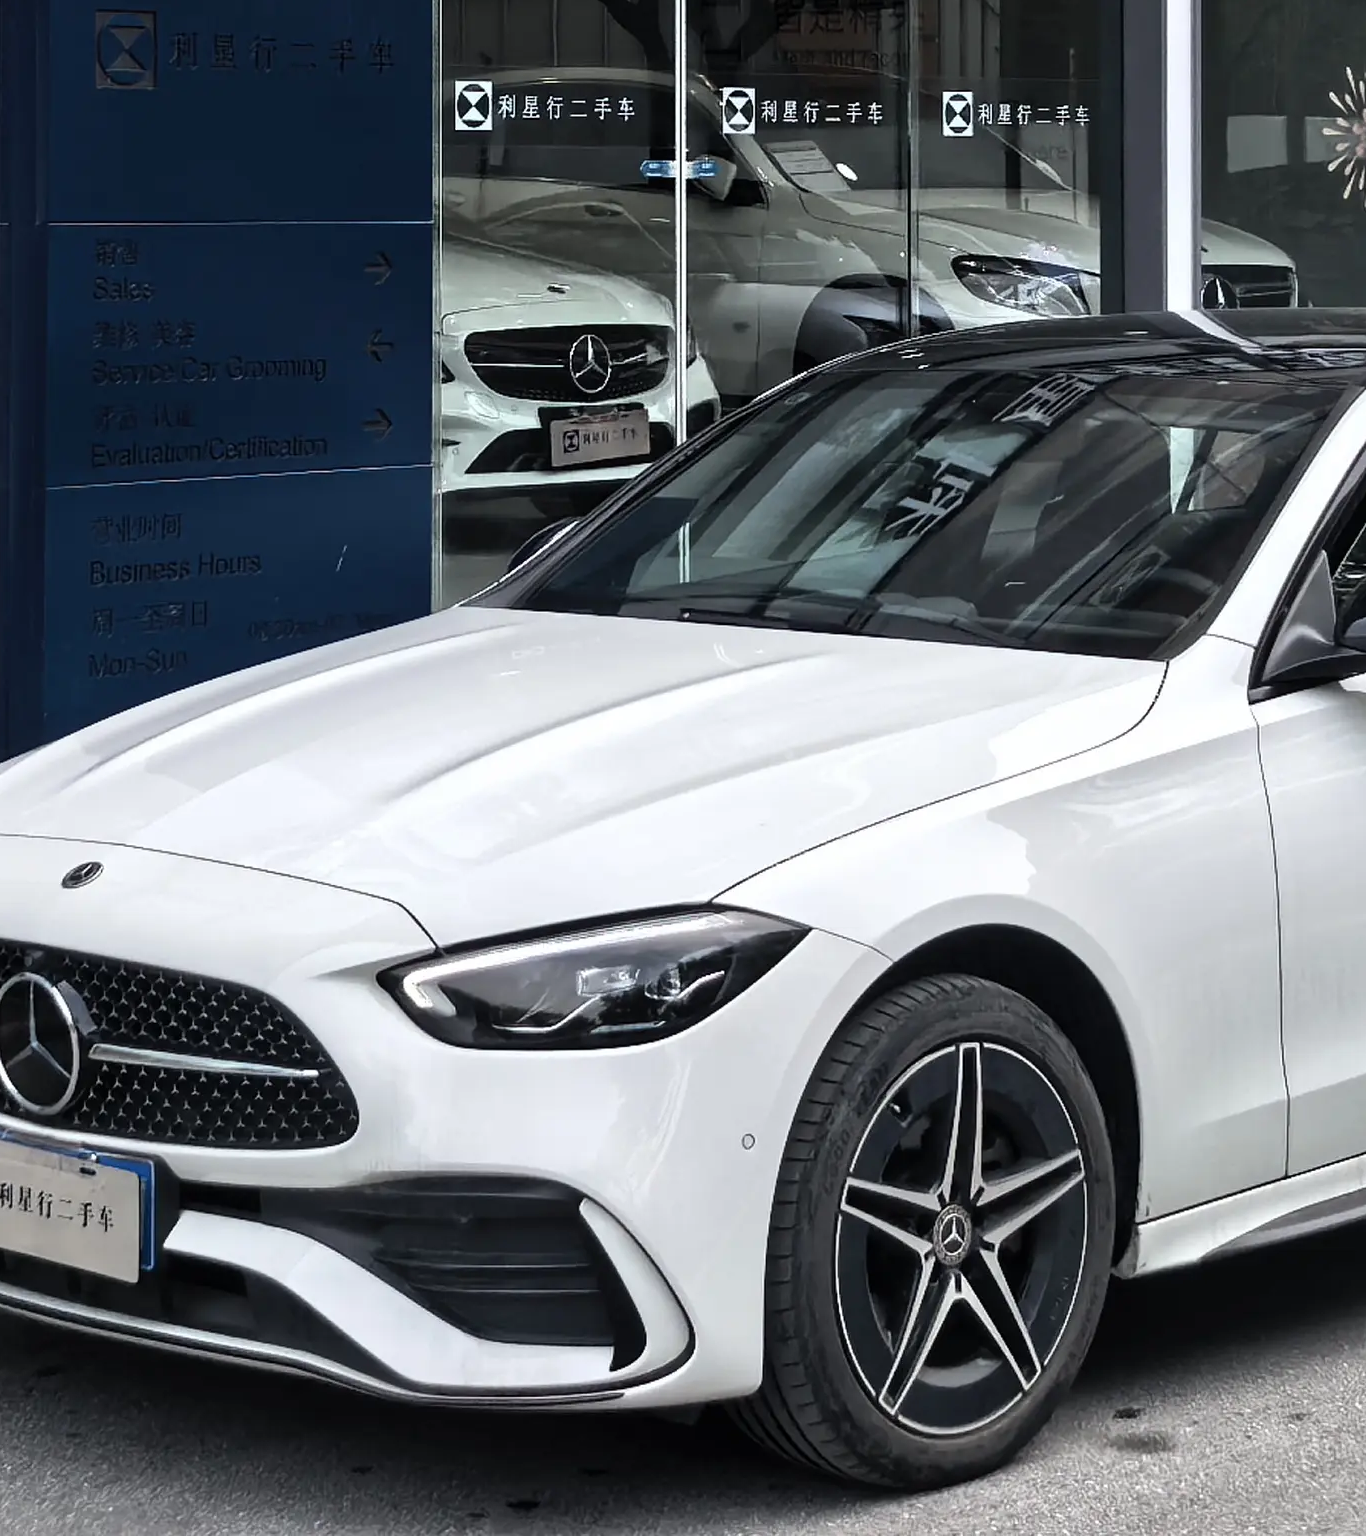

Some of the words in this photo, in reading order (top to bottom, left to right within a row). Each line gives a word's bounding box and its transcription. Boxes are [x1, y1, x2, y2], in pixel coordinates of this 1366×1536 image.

[168, 30, 396, 76] 利星行二手车
[498, 94, 636, 122] 利星行二手车
[761, 100, 884, 125] 利星行二手车
[977, 103, 1091, 127] 利星行二手车
[93, 275, 155, 302] Sales
[226, 353, 327, 385] Grooming
[89, 557, 191, 587] Business
[197, 550, 263, 577] Hours
[87, 646, 189, 680] Mon-Sun
